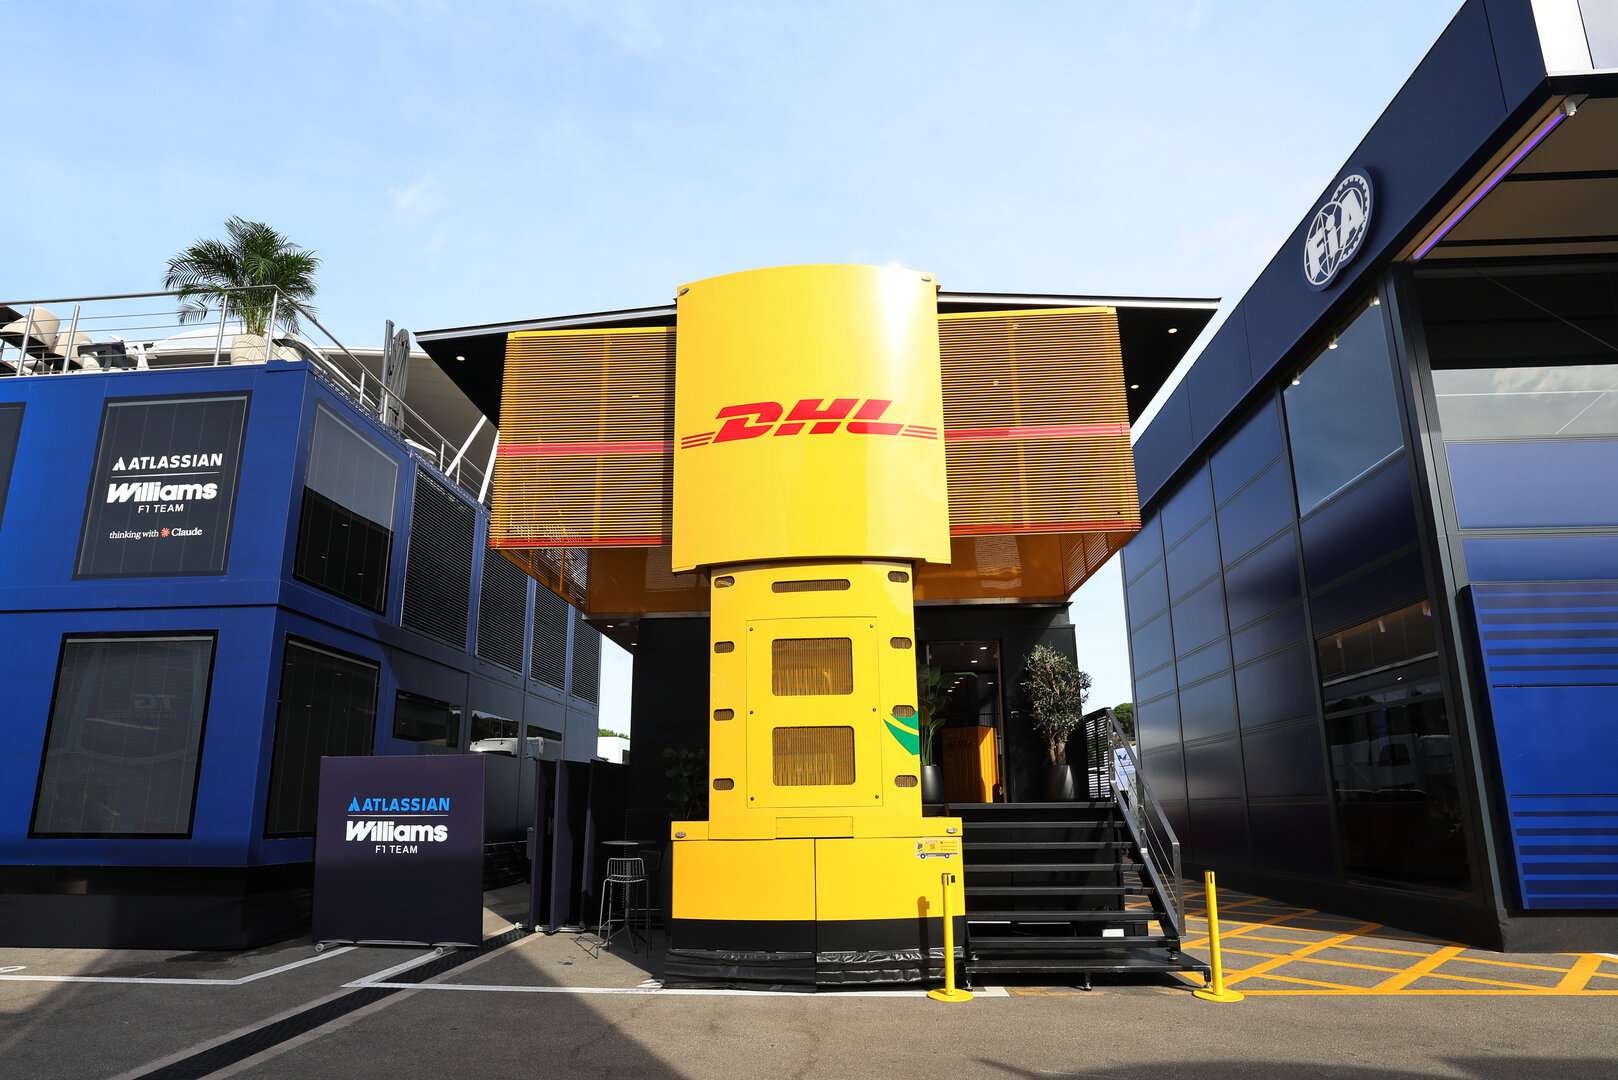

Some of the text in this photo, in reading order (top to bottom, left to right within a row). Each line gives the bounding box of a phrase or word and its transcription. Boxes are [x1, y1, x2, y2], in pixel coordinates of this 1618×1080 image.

[711, 398, 905, 444] DHL
[127, 453, 223, 470] ATLASSIAN
[106, 481, 218, 504] Williams
[137, 503, 185, 514] F1 TEAM
[109, 527, 203, 540] thinking with Claude
[361, 797, 451, 812] ATLASSIAN
[345, 820, 449, 843] Williams
[375, 845, 418, 854] F1 TEAM
